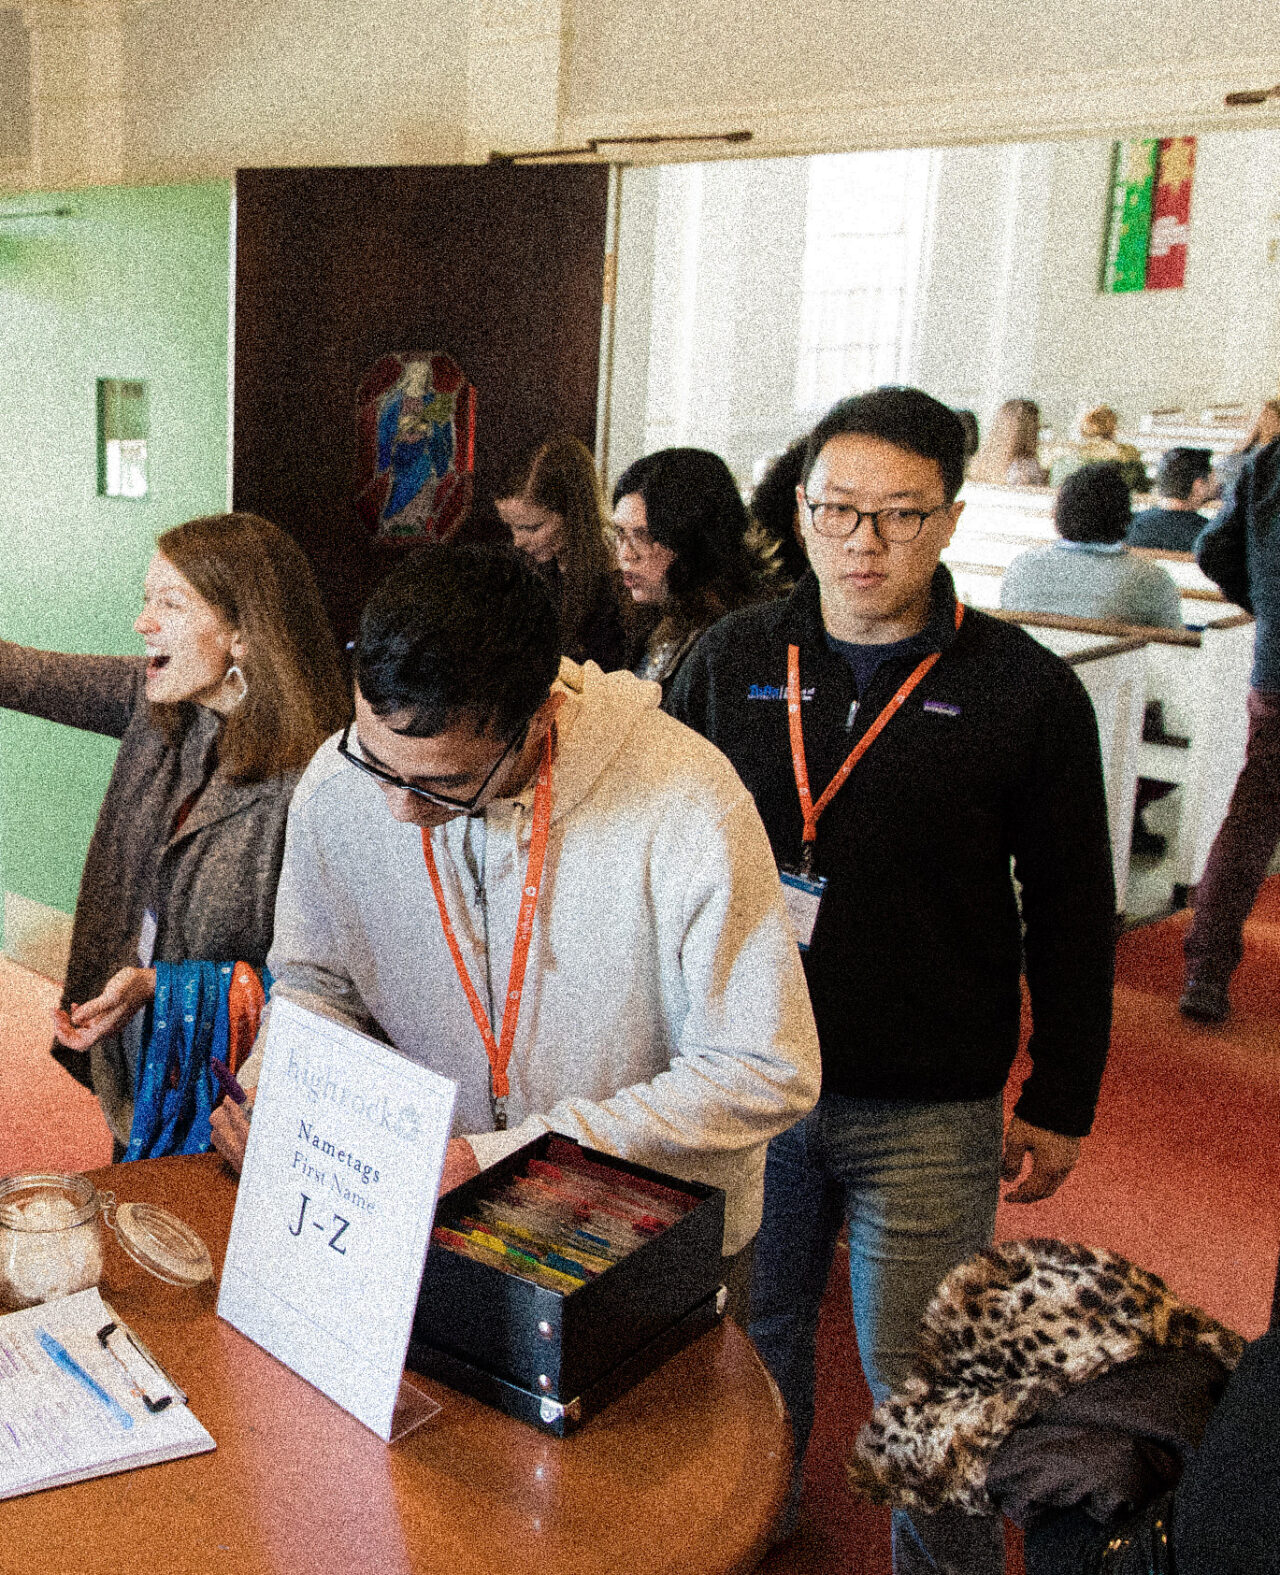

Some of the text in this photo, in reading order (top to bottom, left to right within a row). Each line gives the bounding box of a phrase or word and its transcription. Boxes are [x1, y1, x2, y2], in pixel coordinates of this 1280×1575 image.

[291, 1150, 376, 1214] First Name
[297, 1119, 381, 1185] Nametags
[288, 1191, 351, 1256] J-Z
